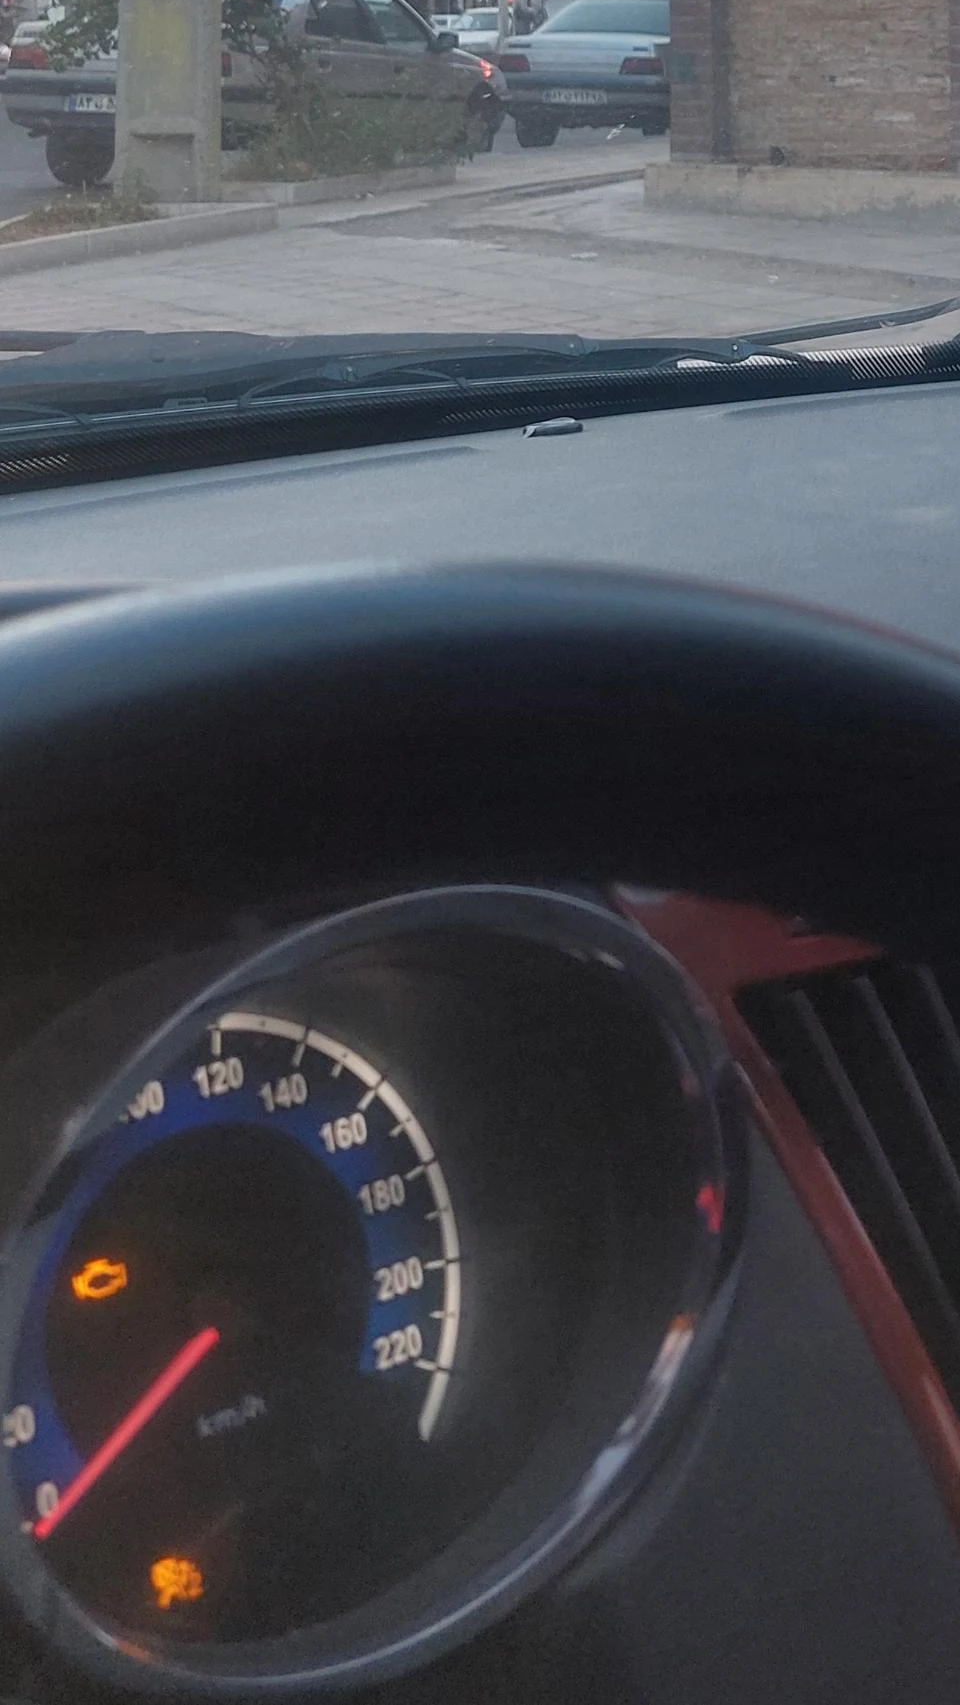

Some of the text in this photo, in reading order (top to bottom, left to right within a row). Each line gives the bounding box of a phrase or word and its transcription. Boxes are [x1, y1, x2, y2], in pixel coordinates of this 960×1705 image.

[195, 1057, 244, 1097] 120
[259, 1073, 308, 1112] 140
[319, 1111, 368, 1153] 160
[358, 1172, 406, 1215] 180
[374, 1257, 424, 1301] 200
[373, 1324, 422, 1370] 220
